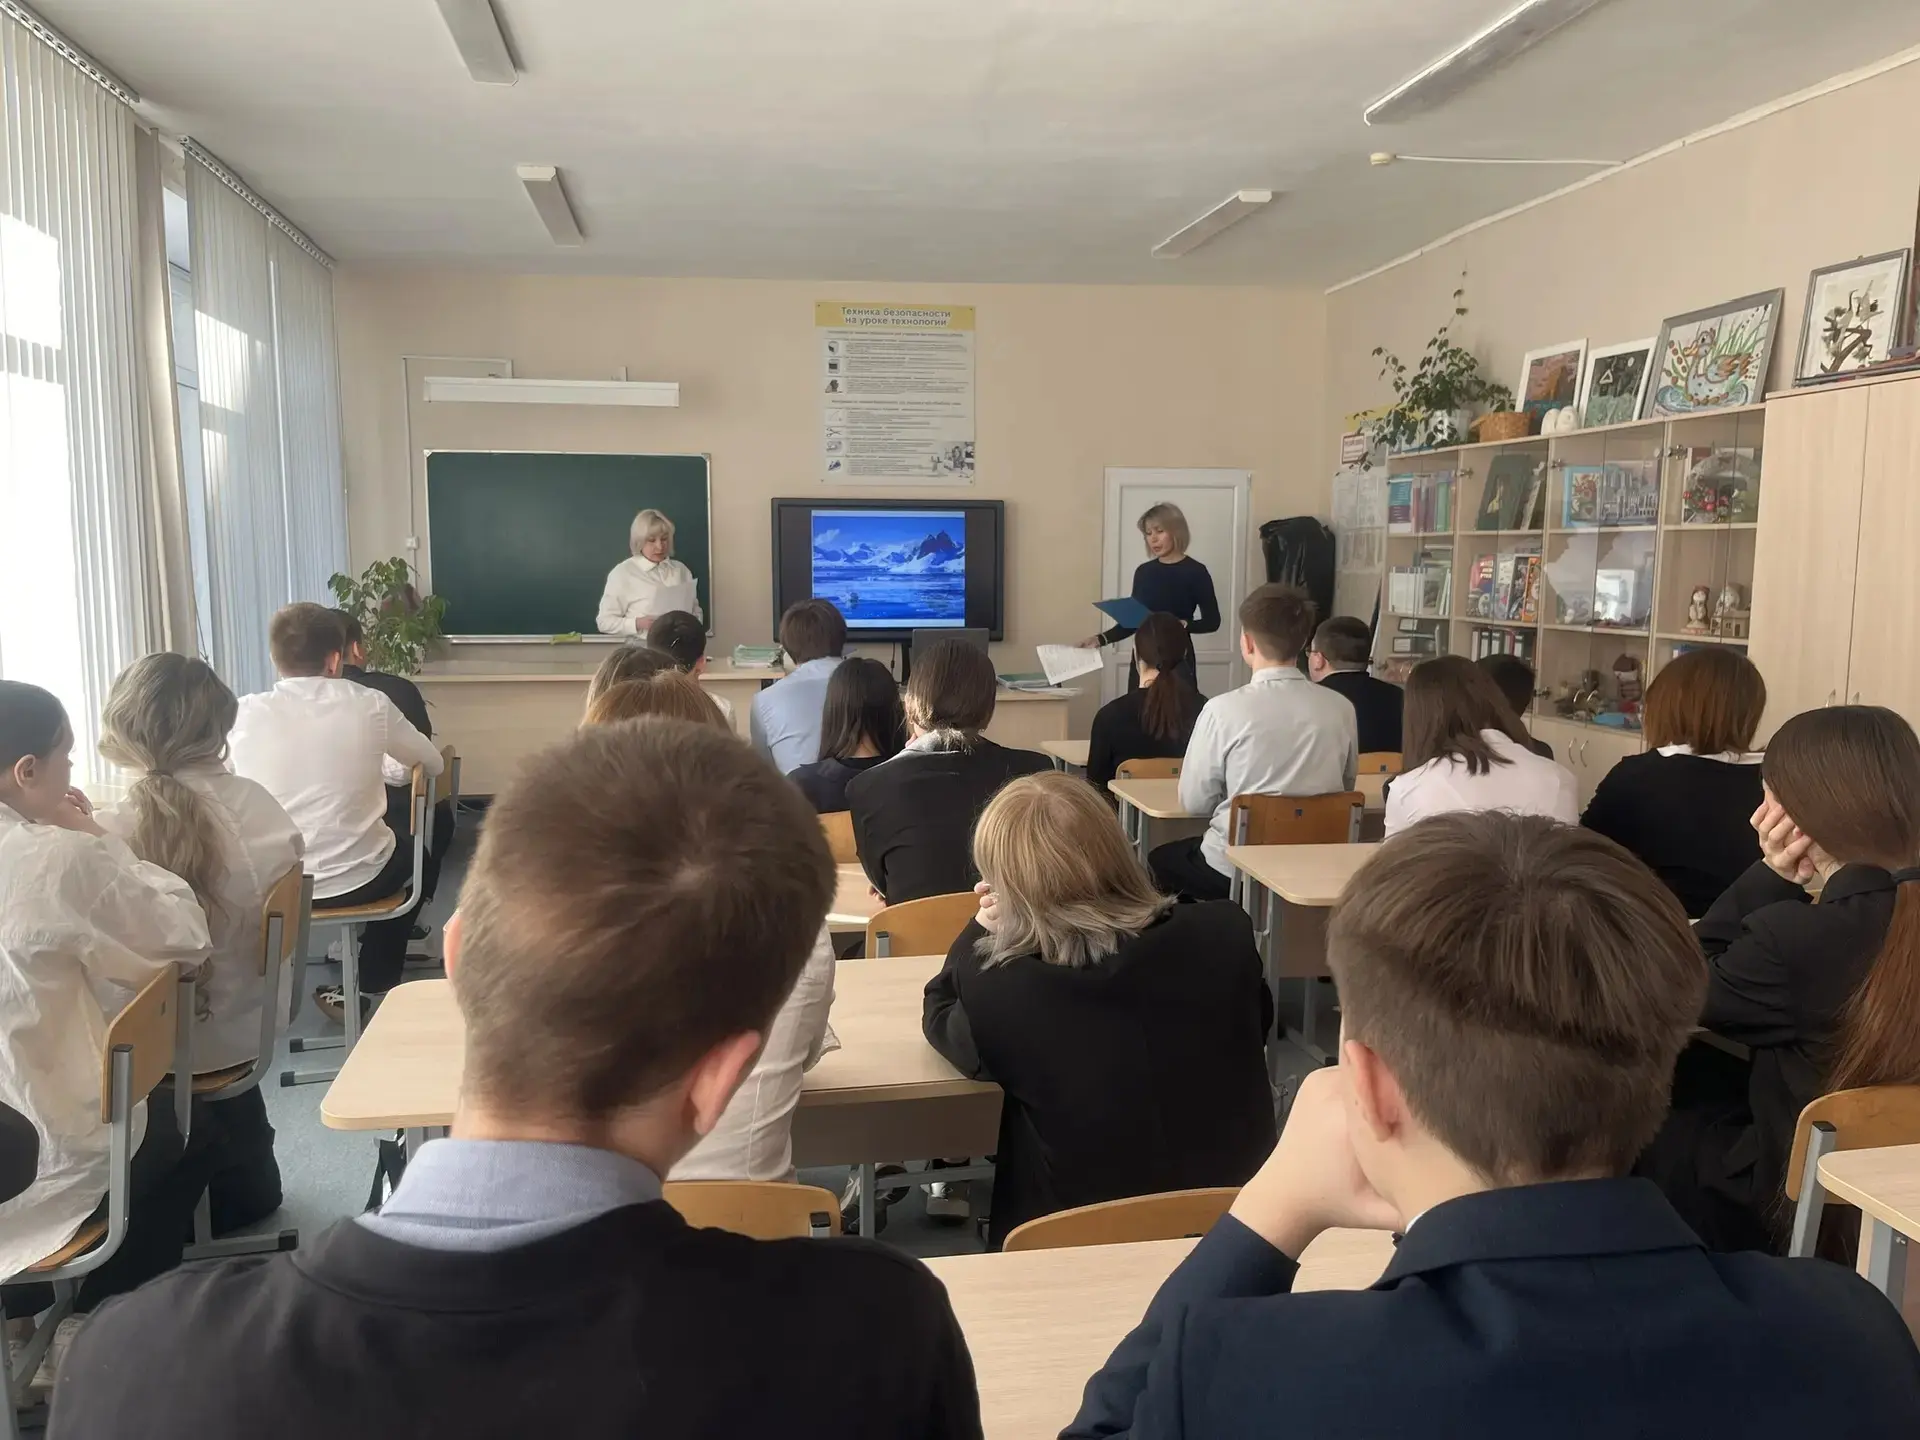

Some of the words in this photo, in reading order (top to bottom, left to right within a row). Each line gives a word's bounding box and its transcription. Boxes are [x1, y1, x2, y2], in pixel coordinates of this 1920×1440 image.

[841, 306, 880, 316] Техника
[883, 308, 951, 317] безопасности
[860, 317, 888, 325] уроке
[891, 318, 947, 326] технологии
